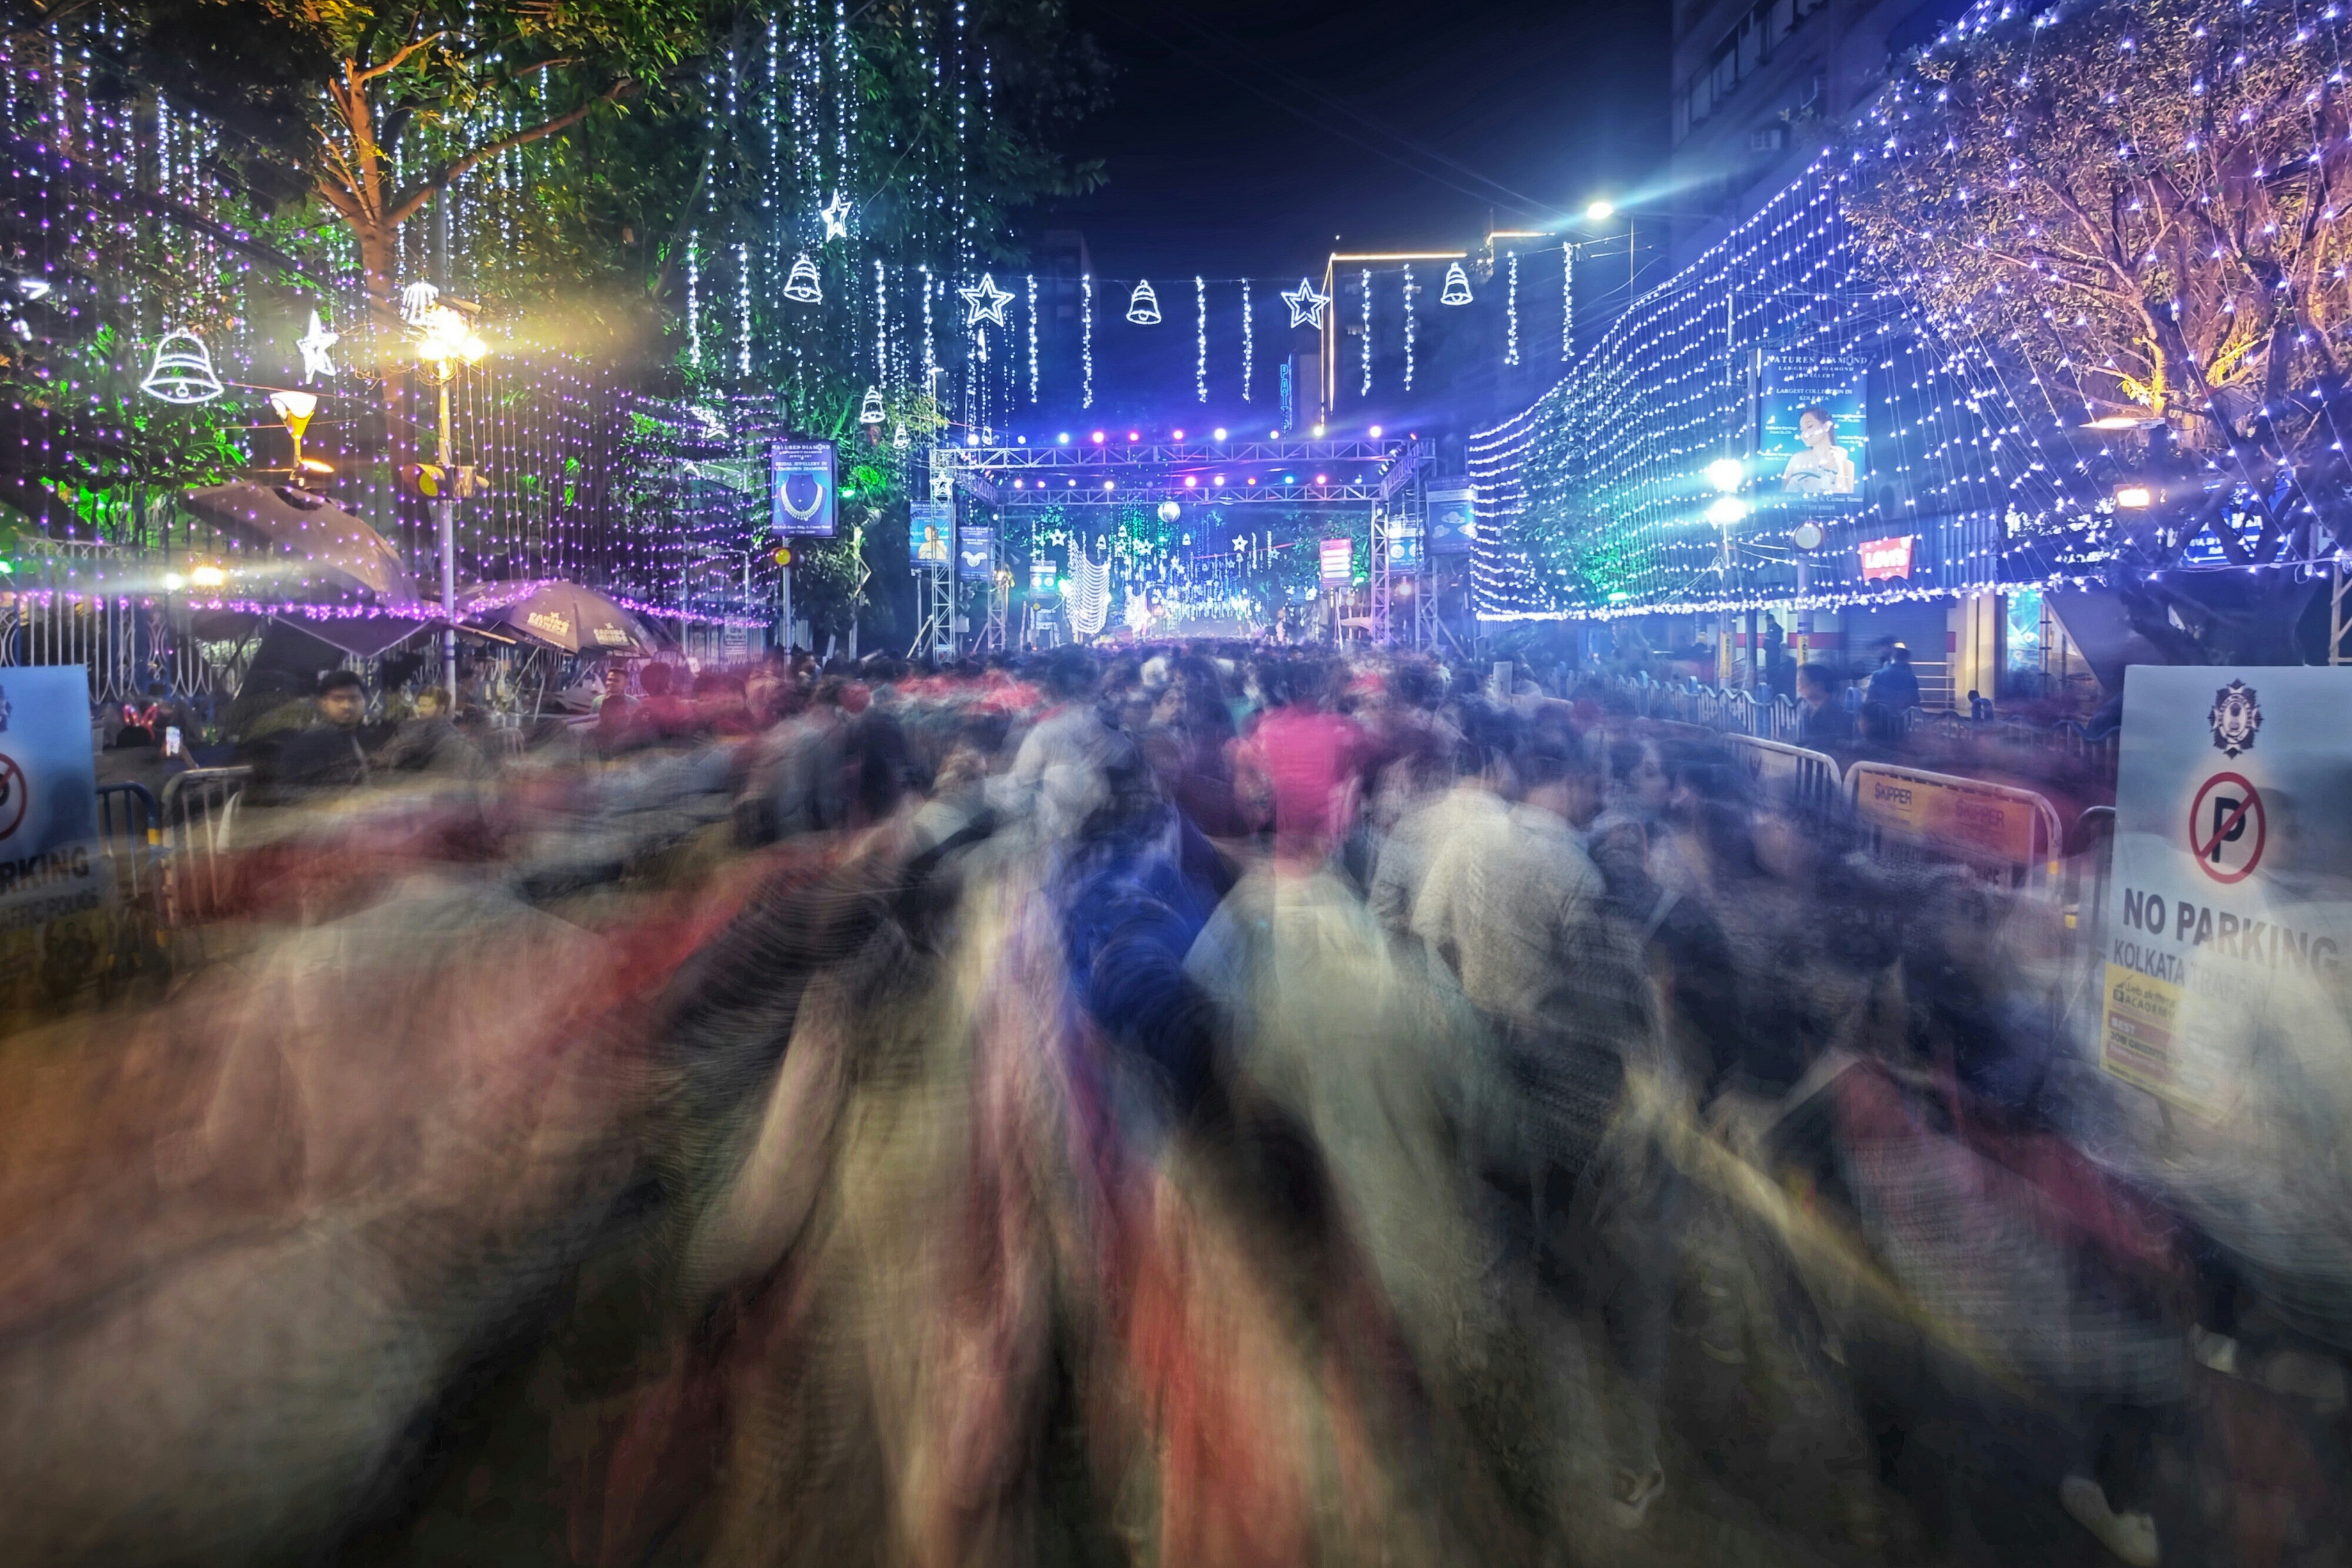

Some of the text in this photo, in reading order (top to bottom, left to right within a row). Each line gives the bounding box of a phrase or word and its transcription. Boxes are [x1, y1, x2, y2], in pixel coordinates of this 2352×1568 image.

[1875, 782, 1912, 805] SKIPPER
[2123, 887, 2340, 975] NO PARKING
[2114, 938, 2185, 987] KOLKATA
[2111, 1017, 2136, 1034] BEST
